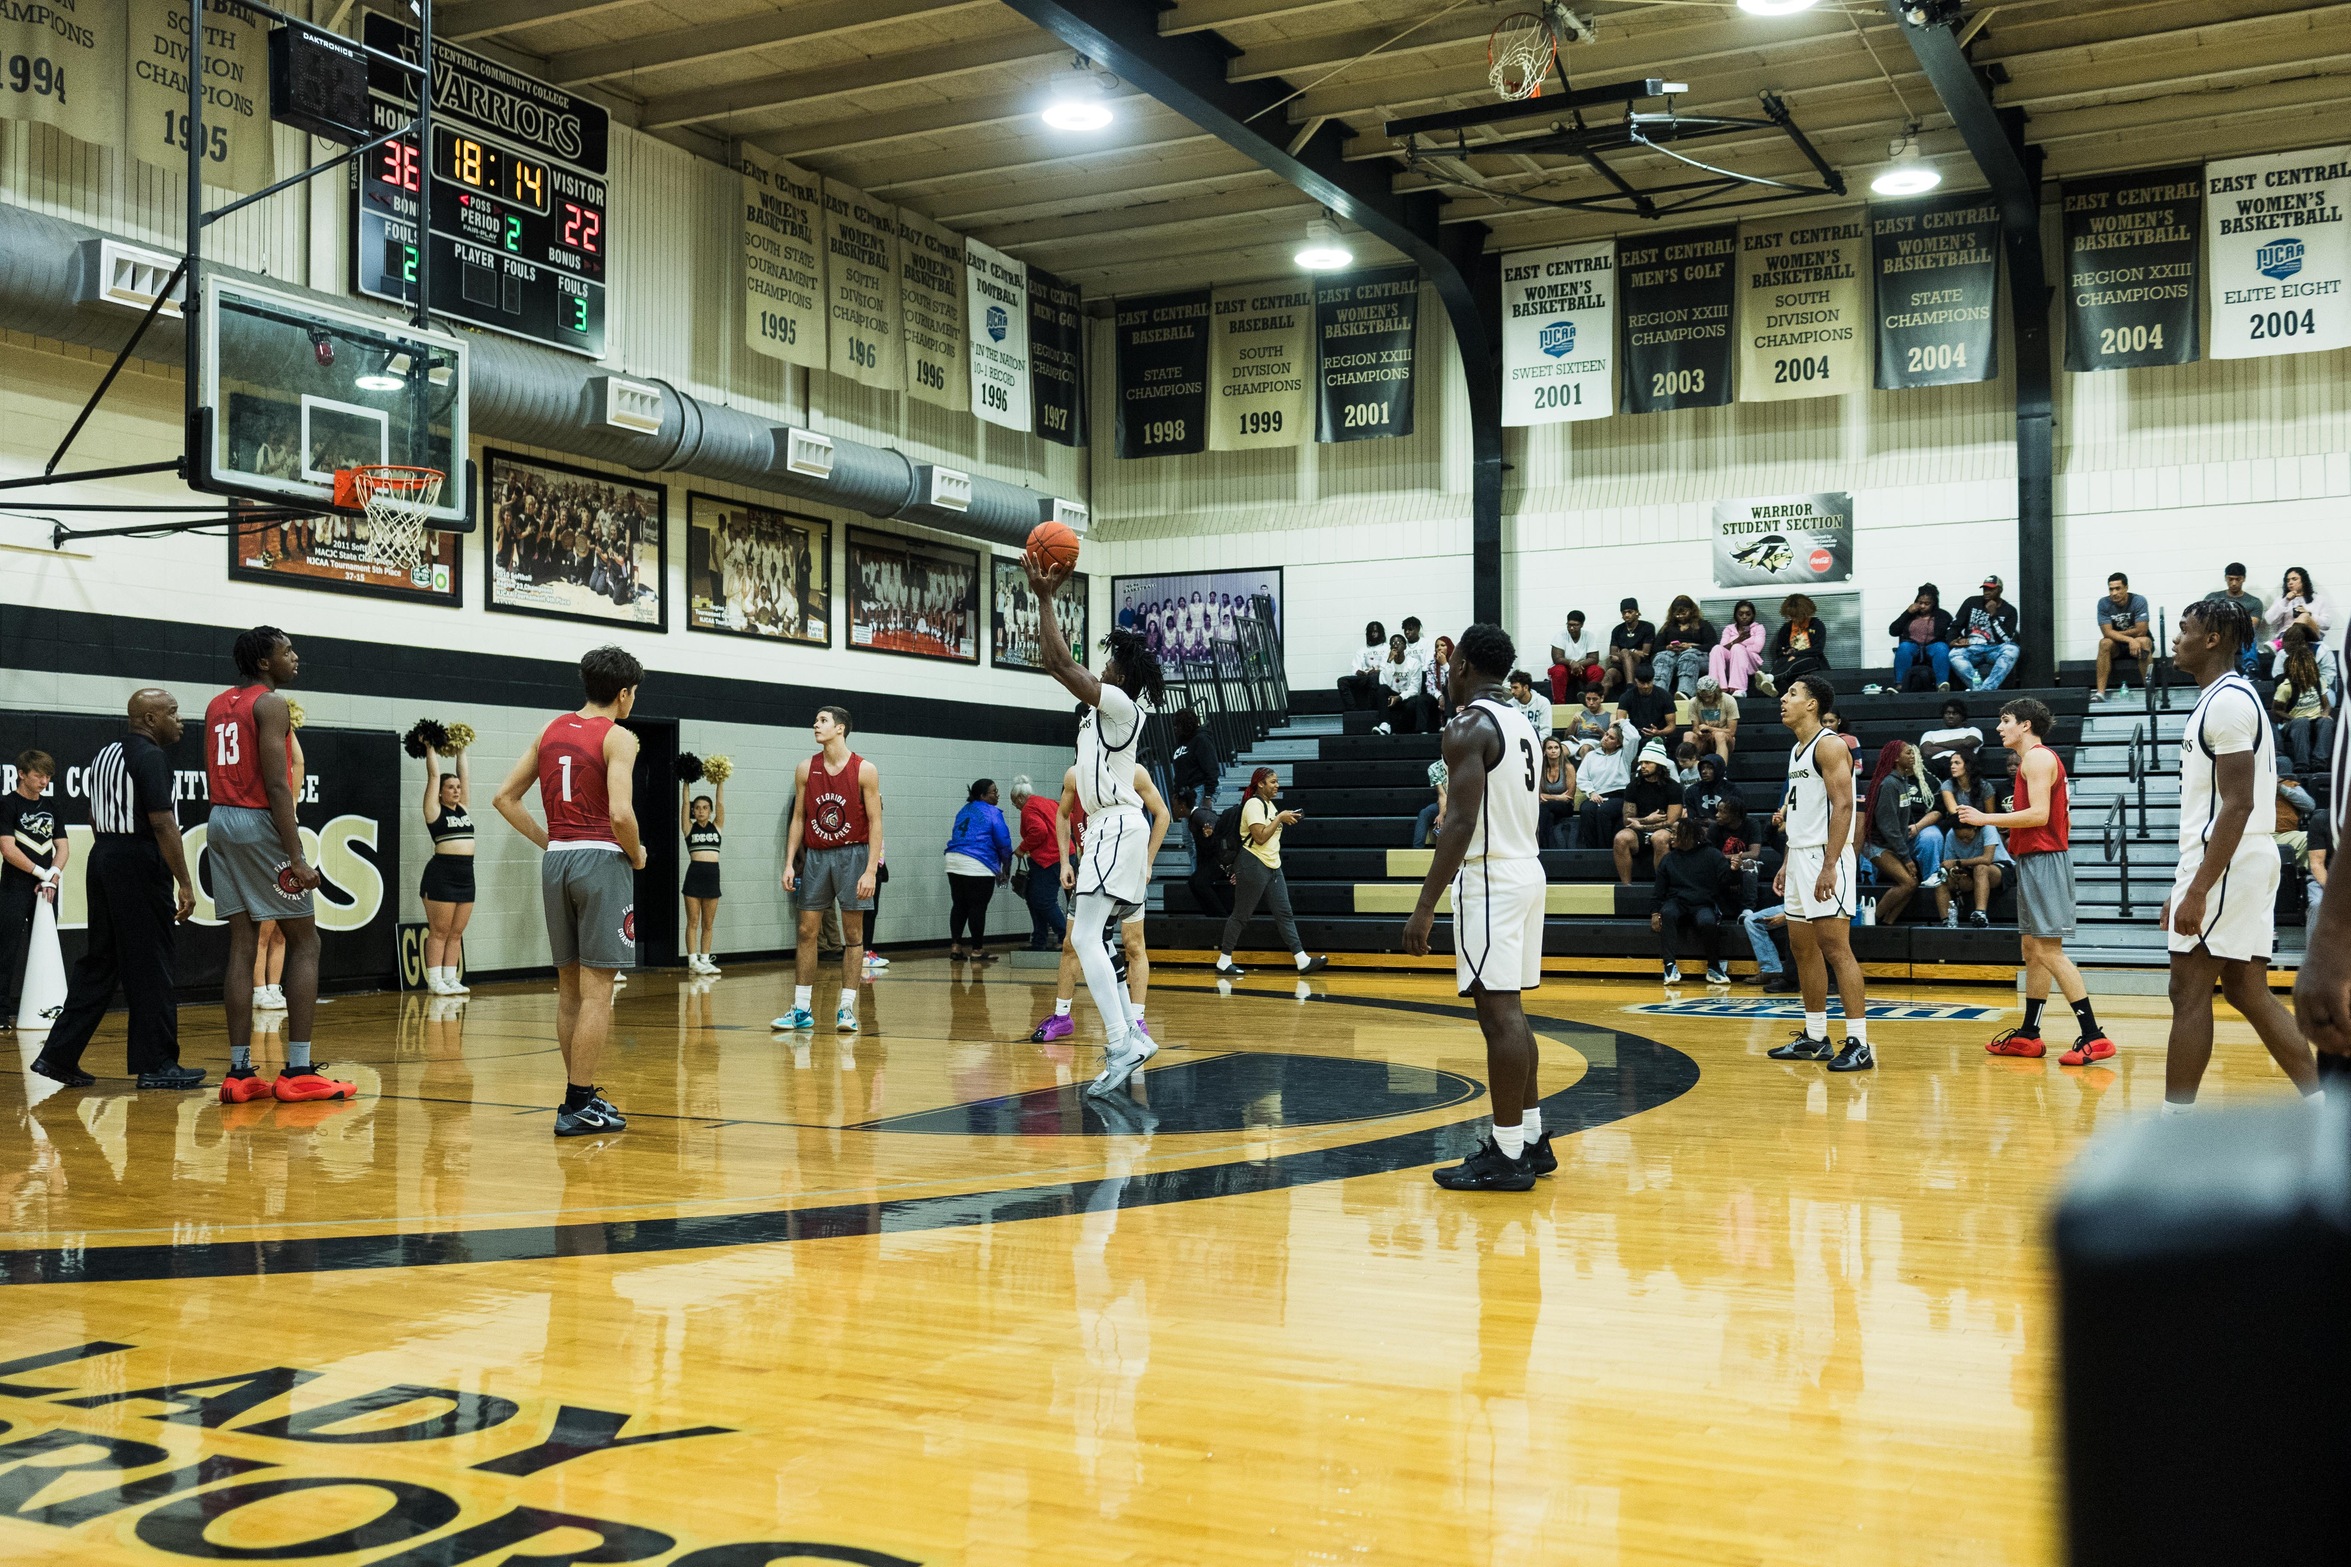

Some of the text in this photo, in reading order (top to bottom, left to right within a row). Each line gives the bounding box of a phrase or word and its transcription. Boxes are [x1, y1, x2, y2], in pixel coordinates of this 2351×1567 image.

[167, 11, 236, 51] SOTH
[302, 32, 354, 58] DAKTRONICS
[0, 54, 66, 105] 994
[438, 46, 569, 110] CENTRAL COMMUNITY COLLEGE
[398, 44, 582, 159] WARRIORS
[454, 137, 542, 208] 18:14
[742, 159, 819, 205] EAST CENTRAL
[2210, 162, 2351, 195] EAST CENTRAL
[553, 171, 604, 207] VISITOR
[2064, 182, 2200, 212] EAST CENTRAL
[470, 196, 491, 213] POSS
[759, 191, 808, 225] WOMEN'S
[825, 194, 849, 217] EAST
[2236, 191, 2325, 216] WOMEN'S
[461, 206, 500, 233] PERIOD
[462, 224, 498, 240] FAIR-PLAY
[564, 203, 600, 252] 22
[746, 205, 812, 245] BASKETBALL
[1874, 206, 2000, 236] EAST CENTRAL
[2089, 209, 2174, 233] WOMEN'S
[2220, 206, 2343, 235] BASKETBALL
[507, 216, 521, 251] 2
[1743, 223, 1863, 251] EAST CENTRAL
[1897, 232, 1976, 256] WOMEN'S
[2074, 225, 2191, 252] BASKETBALL
[454, 243, 536, 282] PLAYER FOULS
[548, 247, 581, 270] BONUS
[745, 232, 815, 269] SOUTH STATE
[967, 251, 986, 273] EAST
[1621, 238, 1735, 267] EAST CENTRAL
[1765, 250, 1840, 271] WOMEN'S
[1883, 248, 1992, 274] BASKETBALL
[2256, 242, 2305, 270] NJCAA
[404, 245, 419, 283] 2
[1504, 255, 1613, 282] EAST CENTRAL
[1631, 262, 1725, 288] MEN'S GOLF
[1752, 264, 1855, 288] BASKETBALL
[2072, 263, 2193, 287] REGION XXIII
[558, 275, 588, 298] FOULS
[747, 277, 812, 310] CHAMPIONS
[977, 278, 1018, 308] FOOTBALL
[1318, 279, 1417, 304] EAST CENTRAL
[1524, 280, 1592, 302] WOMEN'S
[1775, 290, 1830, 308] SOUTH
[1911, 289, 1963, 306] STATE
[2076, 284, 2189, 307] CHAMPIONS
[2224, 280, 2342, 305] ELITE EIGHT
[573, 297, 588, 332] 3
[1118, 304, 1210, 327] EAST CENTRAL
[1215, 291, 1310, 315] EAST CENTRAL
[1336, 303, 1399, 322] WOMEN'S
[1512, 294, 1606, 318] BASKETBALL
[760, 310, 796, 345] 1995
[1229, 315, 1294, 334] BASEBALL
[1325, 316, 1411, 339] BASKETBALL
[1628, 305, 1728, 327] REGION XXIII
[1766, 309, 1840, 328] DIVISION
[1885, 306, 1991, 329] CHAMPIONS
[2250, 309, 2315, 340] 2004
[1132, 325, 1194, 345] BASEBALL
[1539, 325, 1576, 350] NJCAA
[1632, 324, 1726, 346] CHAMPIONS
[1754, 328, 1853, 348] CHAMPIONS
[2100, 324, 2163, 354] 2004
[1239, 345, 1283, 360] SOUTH
[1323, 348, 1412, 370] REGION XXIII
[1908, 342, 1967, 372] 2004
[916, 359, 944, 390] 1996
[1144, 366, 1183, 382] STATE
[1232, 362, 1292, 379] DIVISION
[1327, 367, 1410, 387] CHAMPIONS
[1512, 359, 1607, 380] SWEET SIXTEEN
[1774, 355, 1830, 384] 2004
[1126, 382, 1202, 400] CHAMPIONS
[1222, 379, 1302, 397] CHAMPIONS
[1653, 369, 1705, 397] 2003
[982, 382, 1008, 412] 1996
[1534, 383, 1582, 409] 2001
[1044, 403, 1068, 431] 1997
[1240, 410, 1283, 435] 1999
[1344, 402, 1390, 428] 2001
[1144, 419, 1185, 445] 1998
[1751, 503, 1813, 519] WARRIOR
[1722, 514, 1844, 535] STUDENT SECTION
[333, 539, 351, 550] 2011
[339, 549, 357, 560] State
[330, 559, 371, 573] Tournament
[384, 566, 402, 577] Place
[214, 721, 240, 766] 13
[1520, 738, 1535, 792] 3
[558, 755, 572, 802] 1
[815, 792, 847, 807] FLORIDA
[1788, 785, 1797, 811] 4
[691, 832, 720, 844] ECCC
[811, 819, 852, 841] COSTAL PREP
[272, 883, 301, 901] COASTAL
